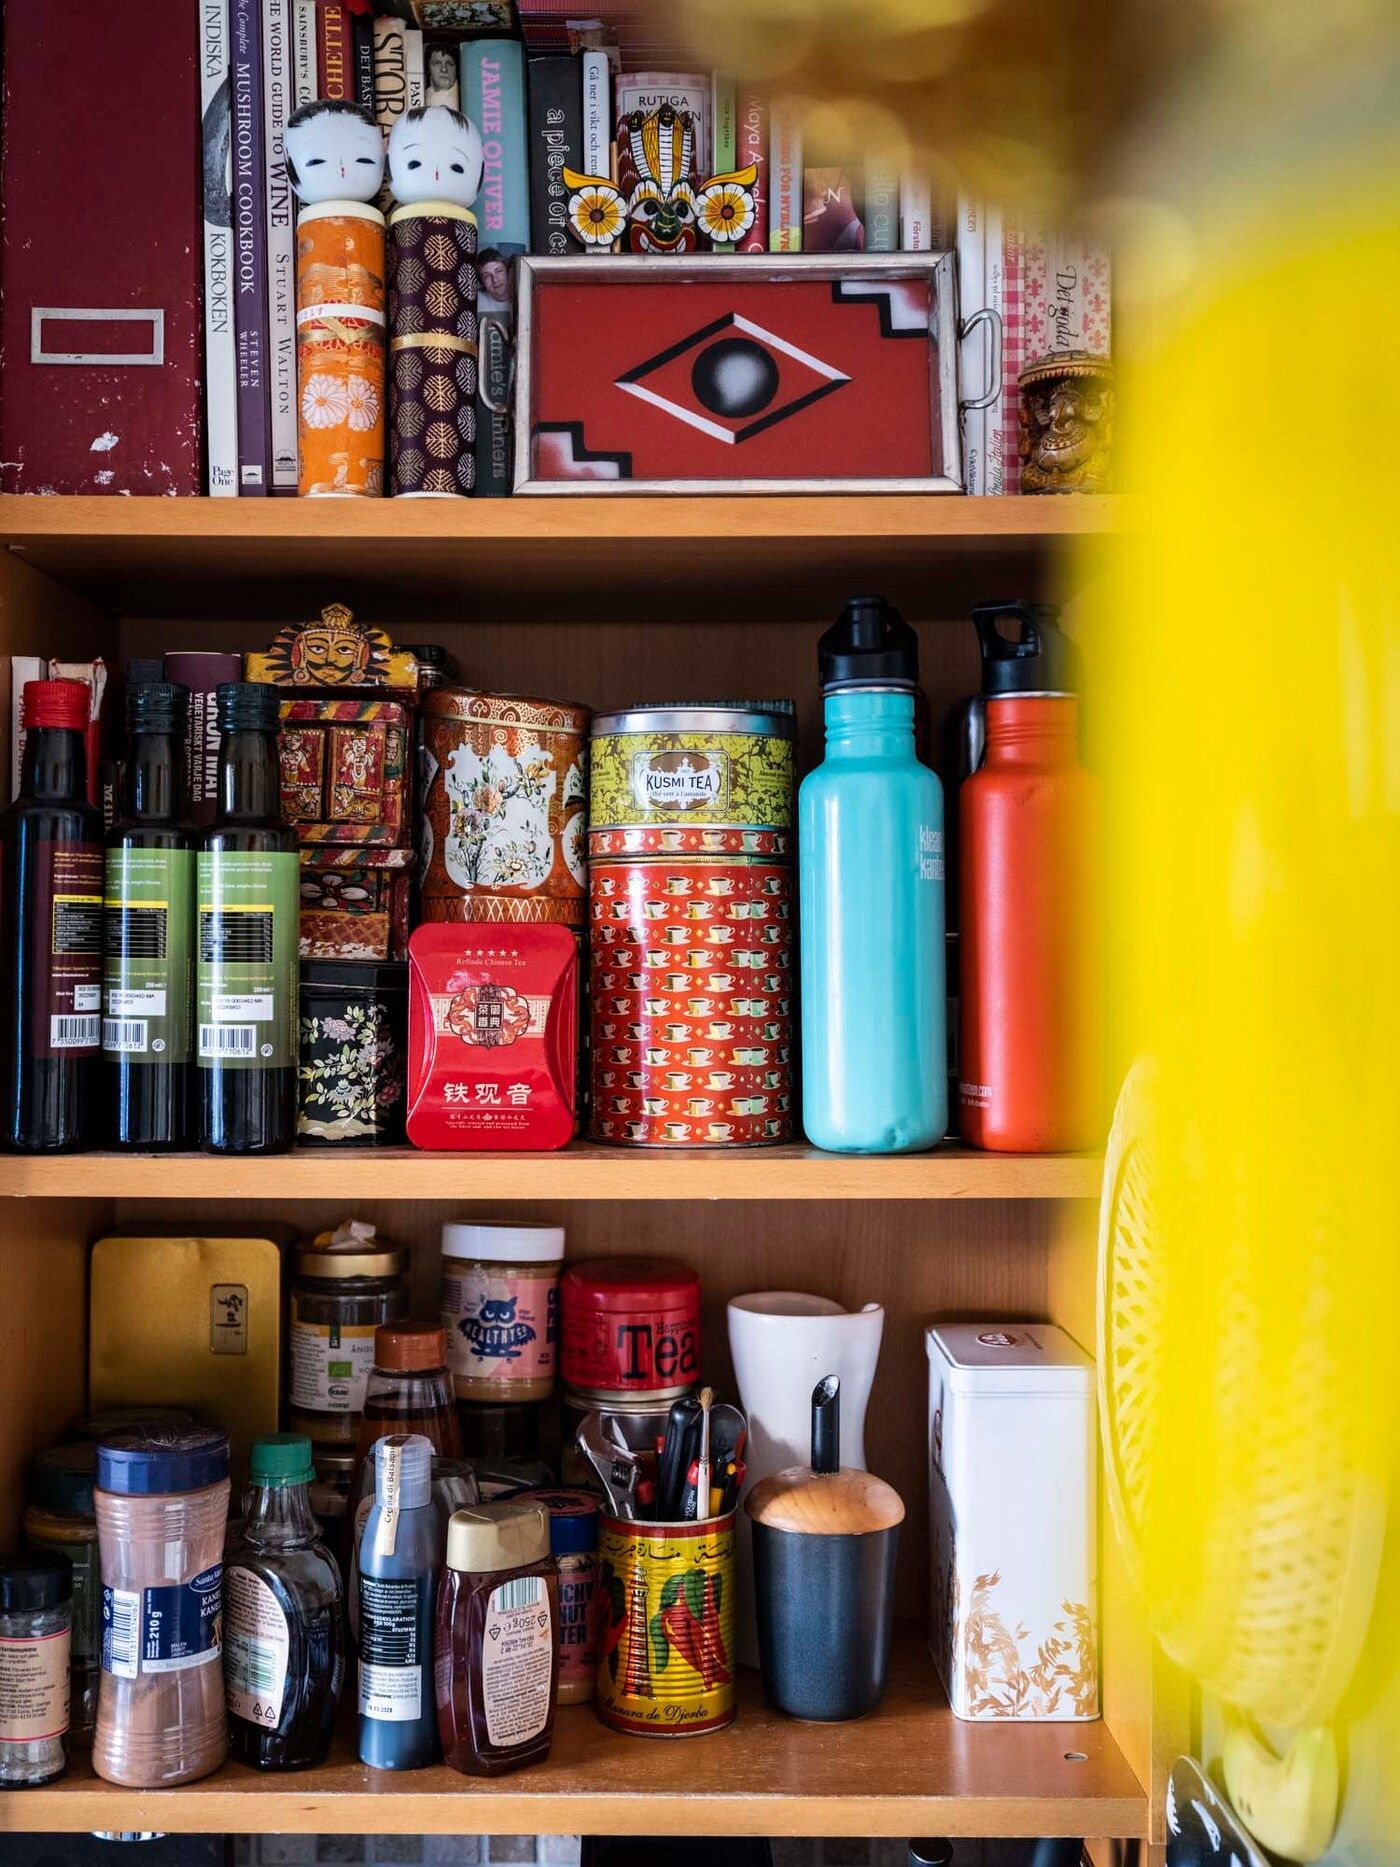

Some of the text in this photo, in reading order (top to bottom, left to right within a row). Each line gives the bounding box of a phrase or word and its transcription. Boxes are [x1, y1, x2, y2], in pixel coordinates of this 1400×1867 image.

[236, 12, 251, 55] Complete
[298, 6, 310, 104] SAINSBURY'S CO
[359, 45, 373, 108] DET BÄST
[410, 81, 421, 107] PAS
[589, 84, 597, 100] ner
[236, 62, 252, 176] MUSHROOM
[270, 0, 289, 228] HE WORLD GUIDE TO WINE
[547, 109, 565, 124] a
[590, 110, 600, 130] vikt
[638, 96, 689, 107] RUTIGA
[743, 95, 764, 145] Maya
[481, 56, 504, 232] JAMIE OLIVER
[590, 133, 601, 151] och
[205, 5, 228, 333] INDISKA KOKBOKEN
[541, 131, 571, 197] piece
[548, 201, 568, 228] of
[779, 195, 791, 251] NYBLIVN
[239, 183, 255, 294] COOKBOOK
[912, 221, 922, 249] Första
[1047, 265, 1079, 348] Det goda
[275, 254, 292, 415] STUART WALTON
[239, 331, 249, 388] WHEELER
[249, 330, 260, 388] STEVEN
[488, 328, 508, 478] amie's inners
[212, 466, 235, 478] Page
[212, 476, 234, 486] One
[192, 692, 204, 802] VEGETARISKT VARJE DAG
[646, 774, 713, 792] KUSMI TEA
[485, 958, 512, 967] Chinese
[443, 1082, 533, 1105] 铁观音
[617, 1324, 698, 1380] Tea
[387, 1446, 395, 1483] Balsami
[387, 1484, 394, 1493] di
[560, 1583, 593, 1602] CHY
[149, 1620, 160, 1640] 210
[662, 1703, 709, 1727] Djerba
